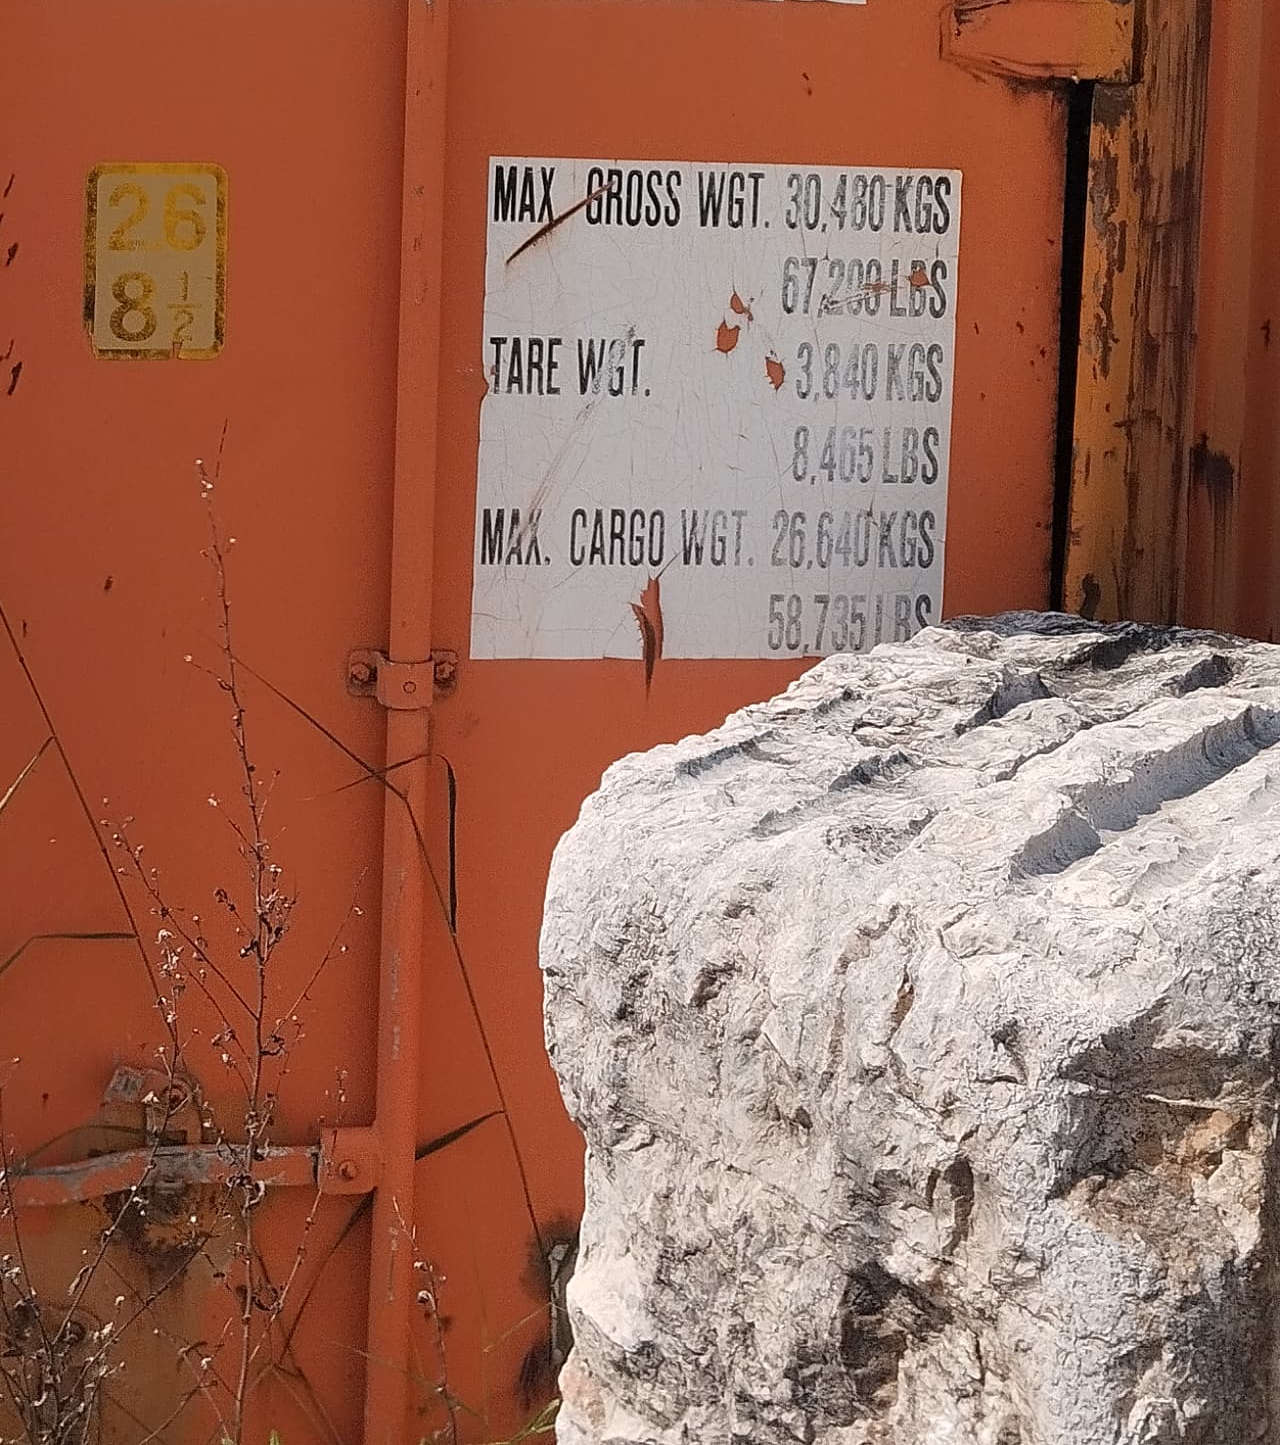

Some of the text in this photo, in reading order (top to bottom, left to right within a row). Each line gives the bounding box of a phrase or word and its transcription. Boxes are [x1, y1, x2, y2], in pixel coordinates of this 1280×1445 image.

[107, 182, 207, 251] 26
[586, 166, 682, 227] GROSS
[698, 171, 770, 229] WGT.
[489, 337, 651, 397] TARE WGT.
[481, 508, 754, 567] MAX. CARGO WGT.
